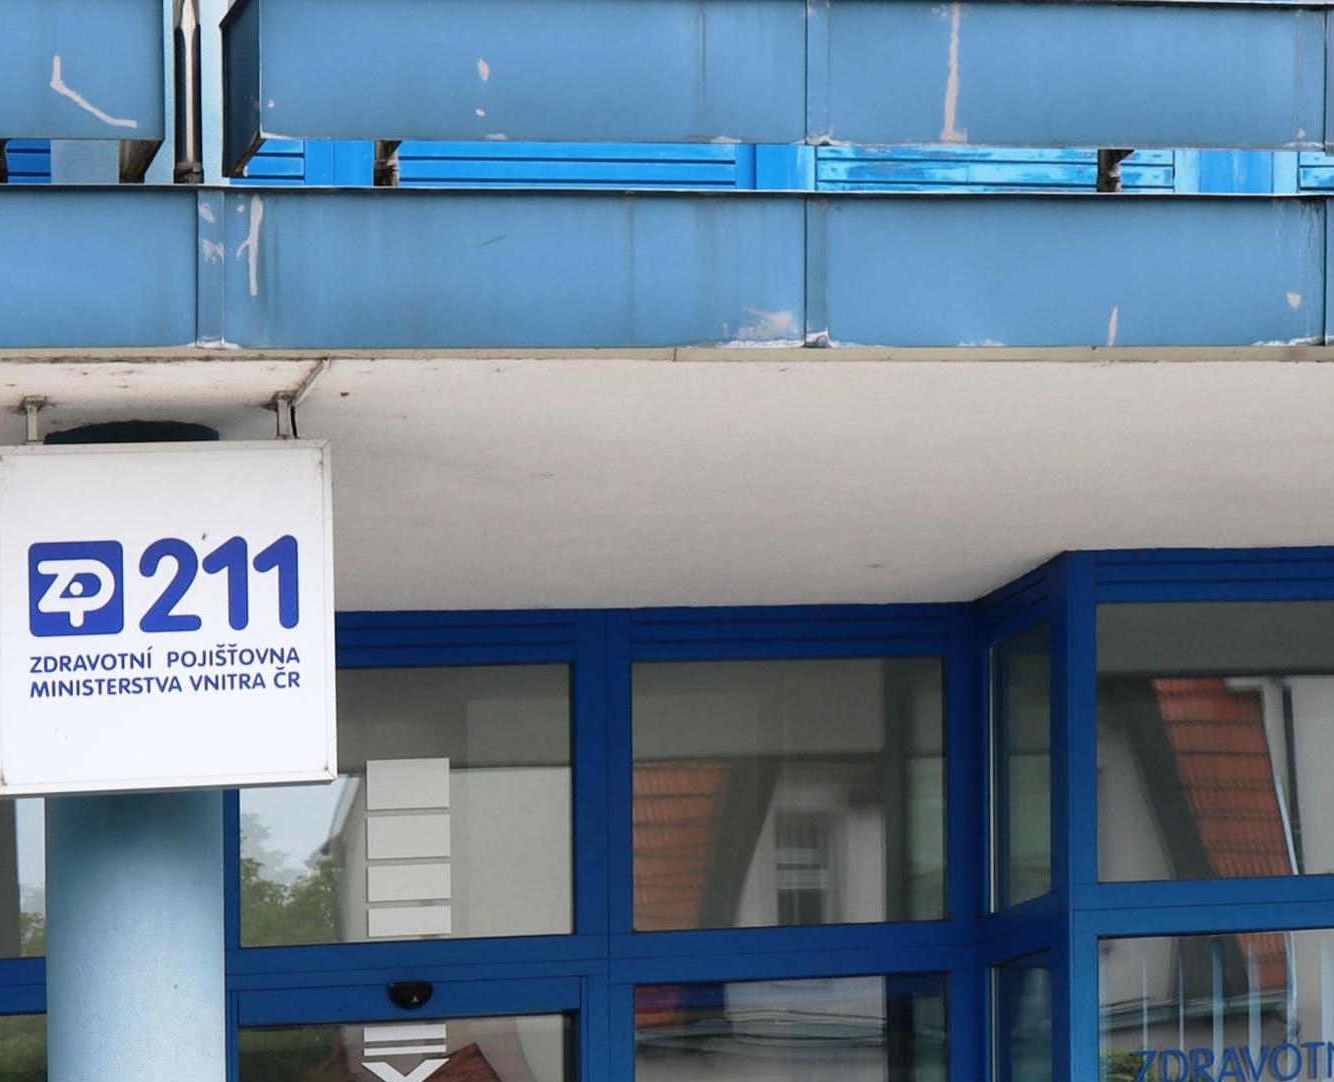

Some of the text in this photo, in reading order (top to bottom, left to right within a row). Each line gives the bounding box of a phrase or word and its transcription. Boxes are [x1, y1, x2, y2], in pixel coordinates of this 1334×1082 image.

[138, 534, 300, 633] 211
[29, 643, 300, 674] ZDRAVOTNÍ POJIŠŤOVNA
[29, 666, 301, 698] MINISTERSTVA VNITRA ČR
